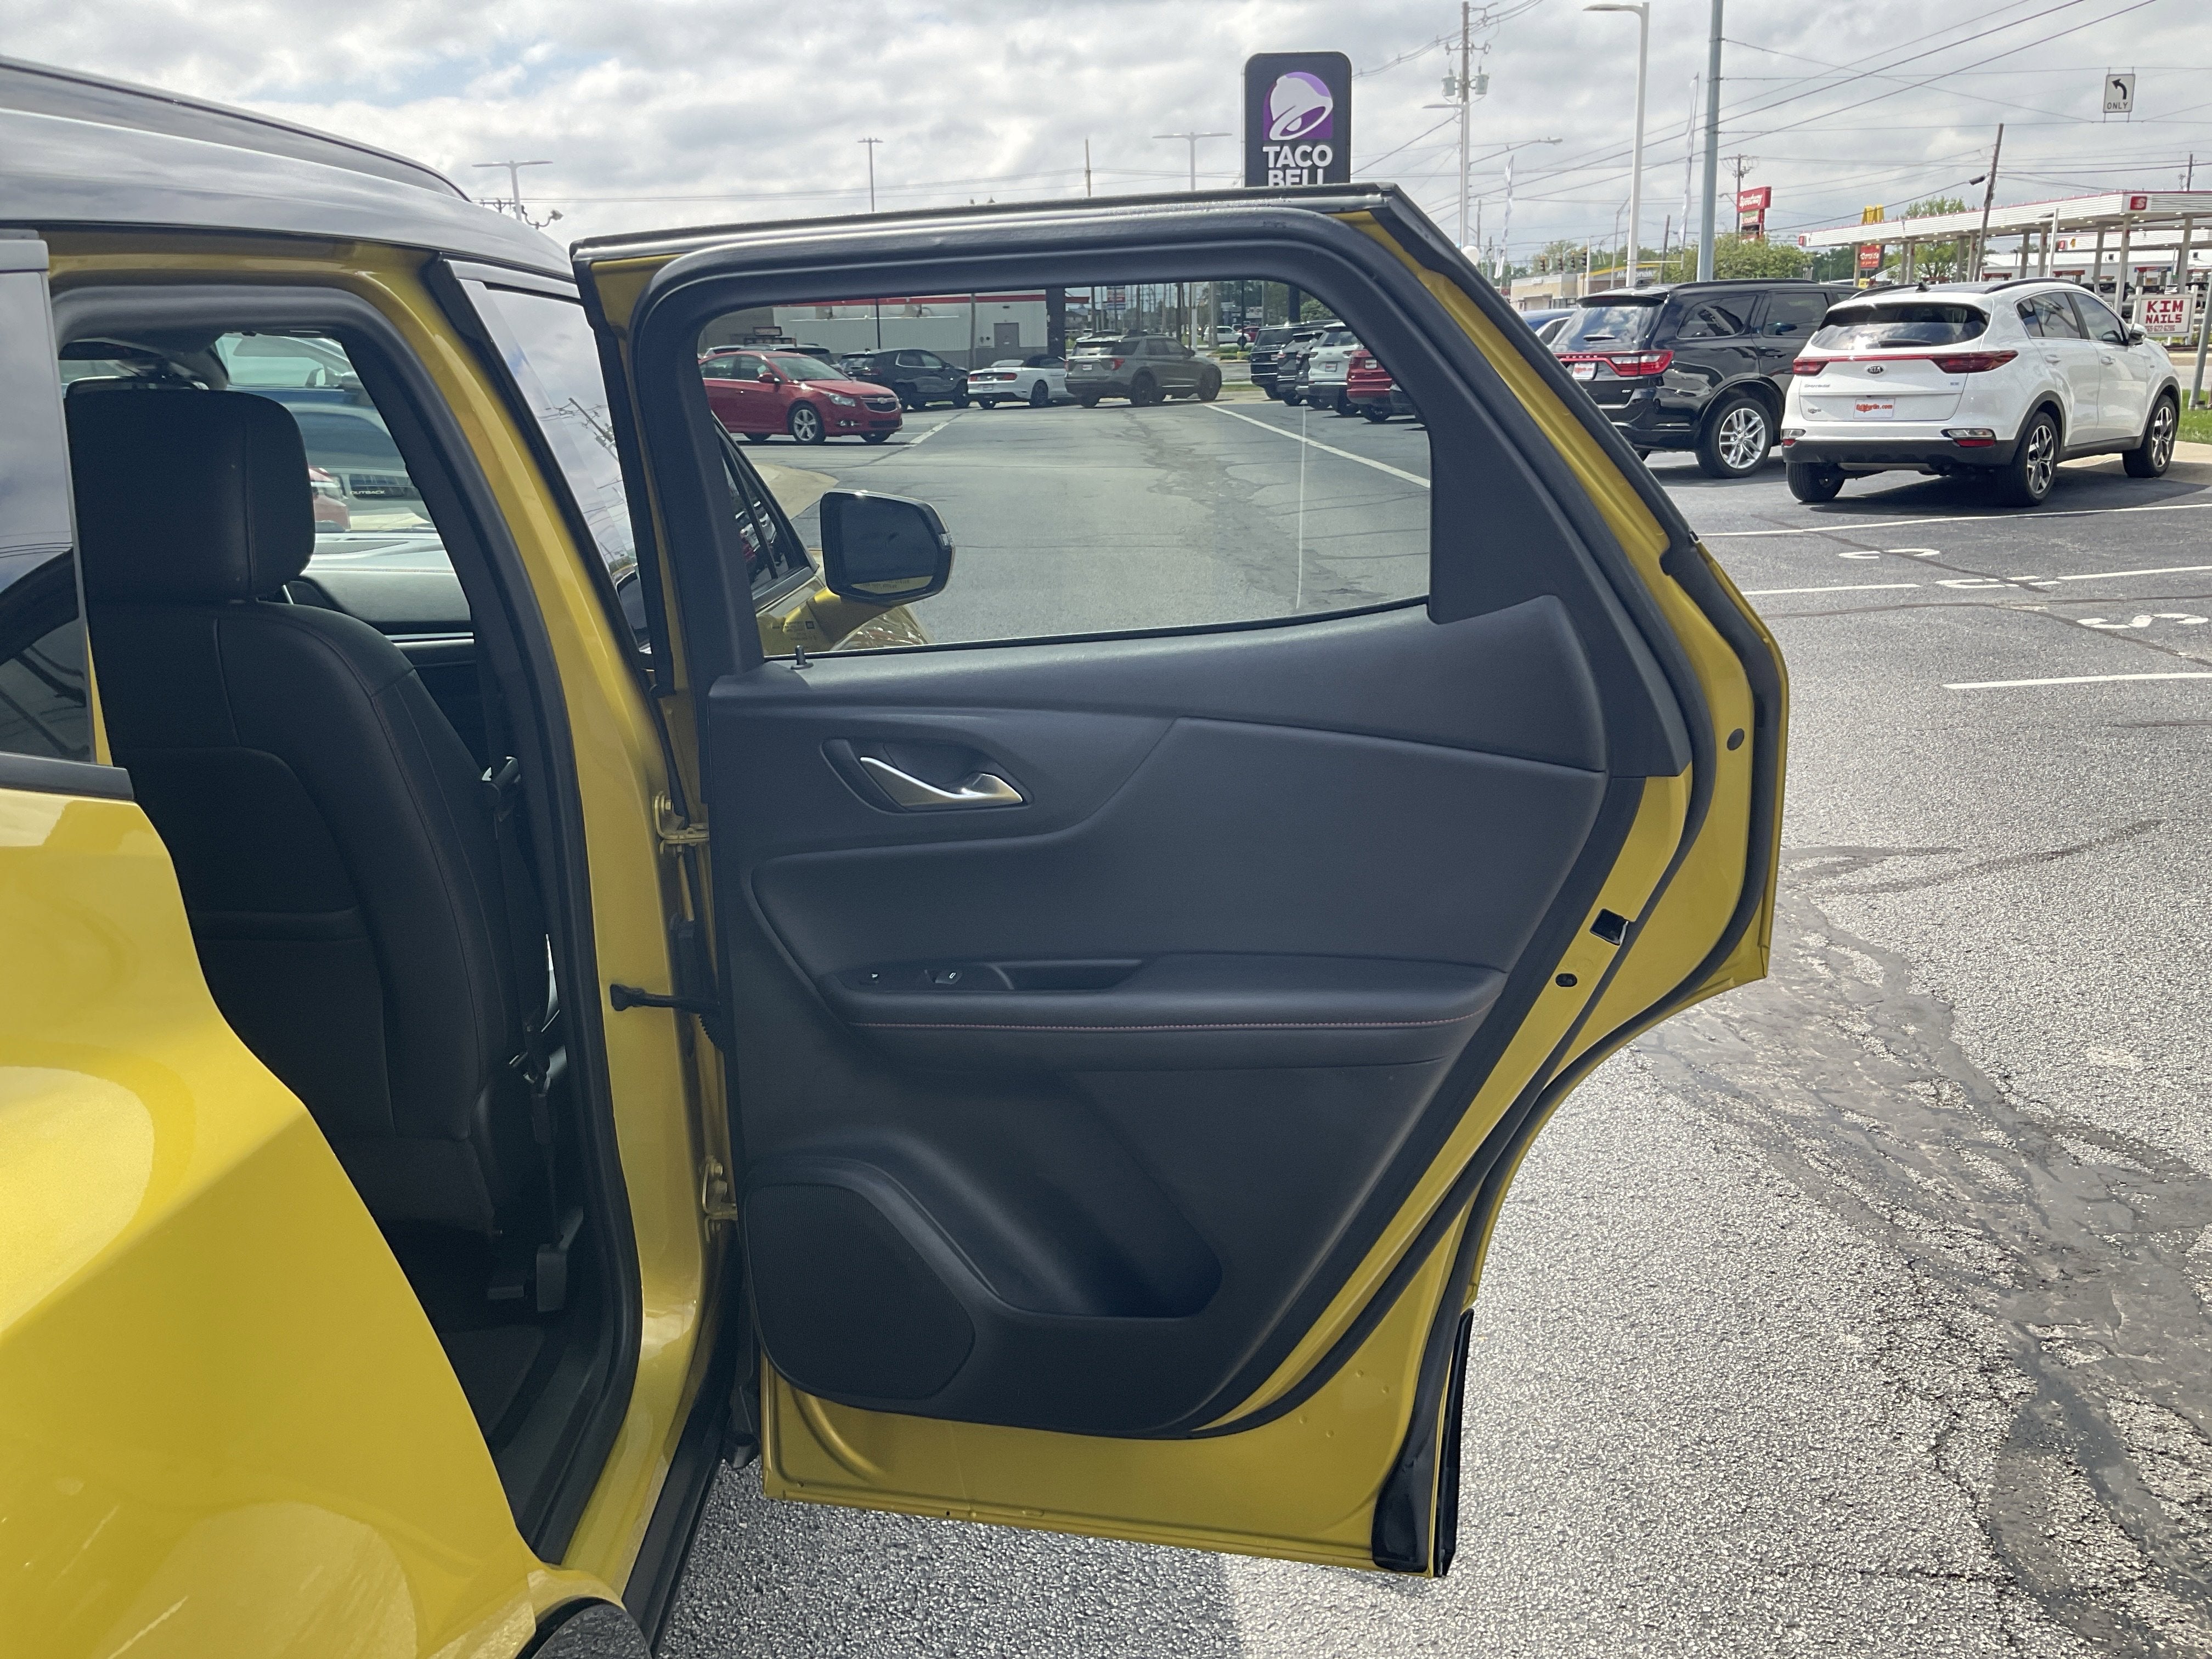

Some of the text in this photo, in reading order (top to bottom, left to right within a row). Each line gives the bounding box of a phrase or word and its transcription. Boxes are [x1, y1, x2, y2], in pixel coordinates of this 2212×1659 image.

[2107, 101, 2129, 110] ONLY
[1262, 145, 1333, 168] TACO
[2147, 300, 2184, 313] KIM
[2146, 314, 2182, 324] NAILS
